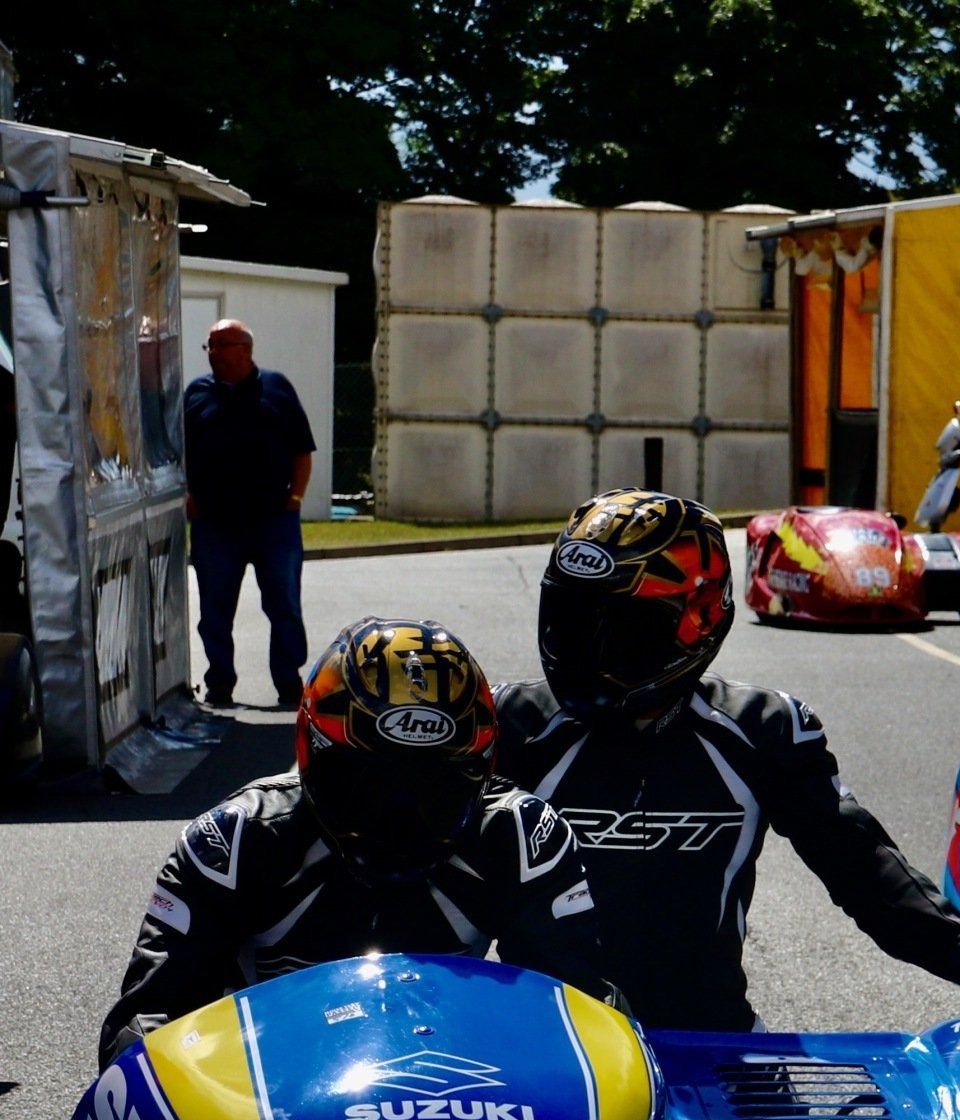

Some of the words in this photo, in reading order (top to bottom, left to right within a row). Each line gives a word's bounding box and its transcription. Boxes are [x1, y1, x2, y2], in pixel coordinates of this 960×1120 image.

[560, 545, 607, 570] Arai
[384, 712, 446, 735] Arai
[530, 803, 558, 860] RST
[557, 808, 745, 851] RST
